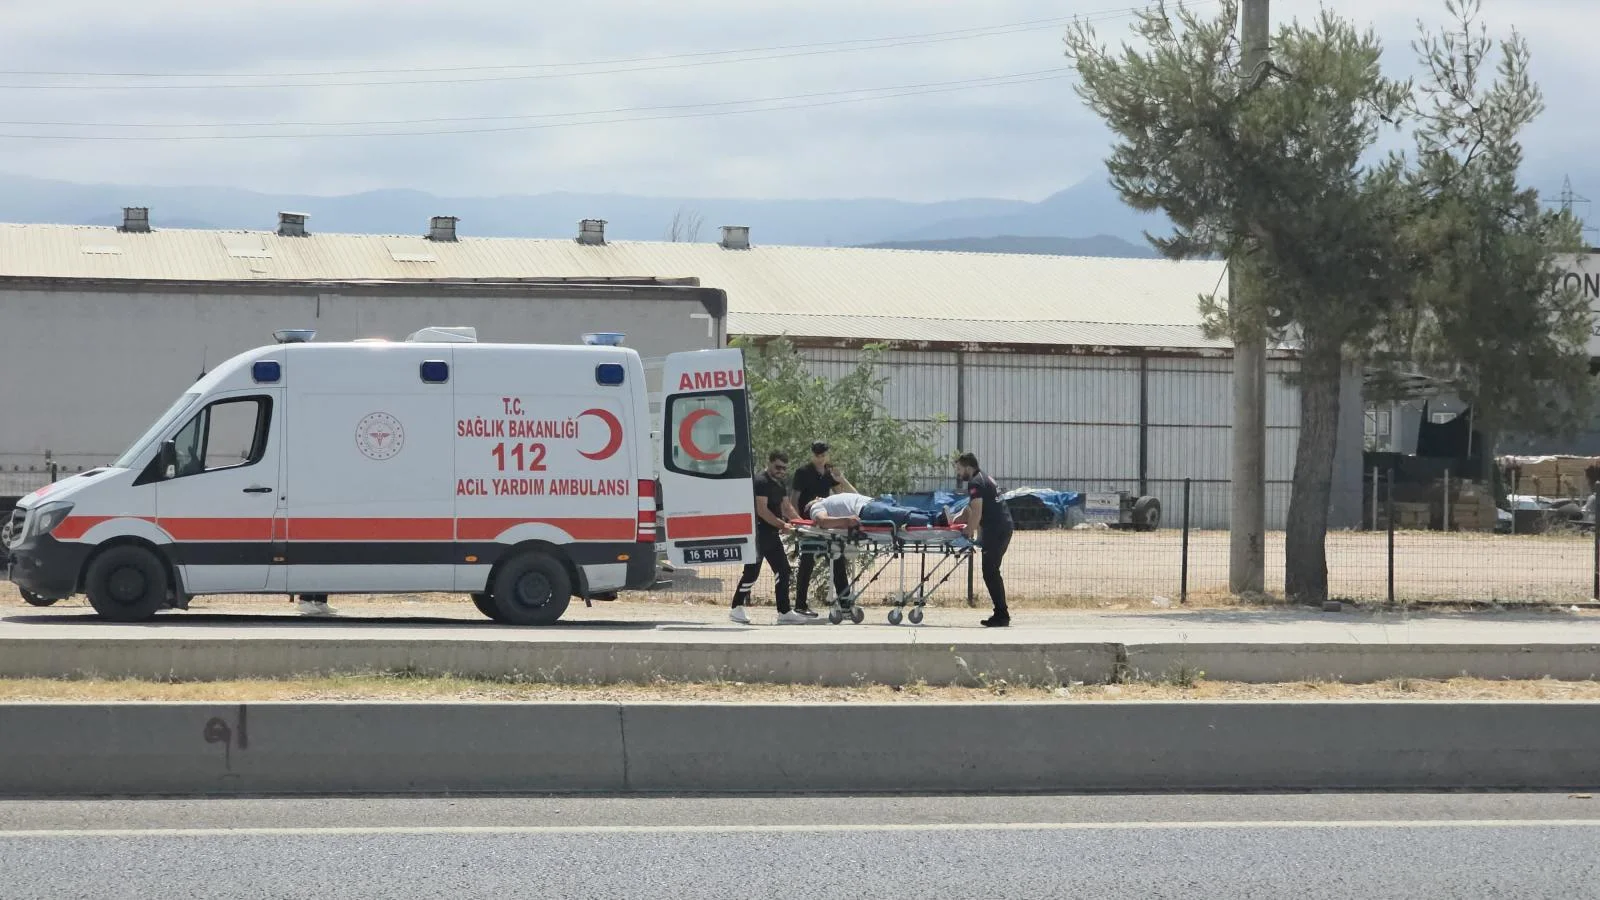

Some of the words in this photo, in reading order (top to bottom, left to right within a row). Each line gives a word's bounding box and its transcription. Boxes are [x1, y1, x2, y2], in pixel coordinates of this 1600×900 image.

[679, 369, 743, 390] AMBU
[502, 397, 525, 415] T.C.
[457, 415, 504, 437] SAĞLIK
[509, 416, 579, 439] BAKANLIĞI
[492, 443, 547, 471] 112
[492, 479, 545, 496] YARDIM
[549, 479, 630, 496] AMBULANSI
[690, 550, 700, 560] 16
[704, 549, 719, 559] RH
[723, 548, 739, 558] 911
